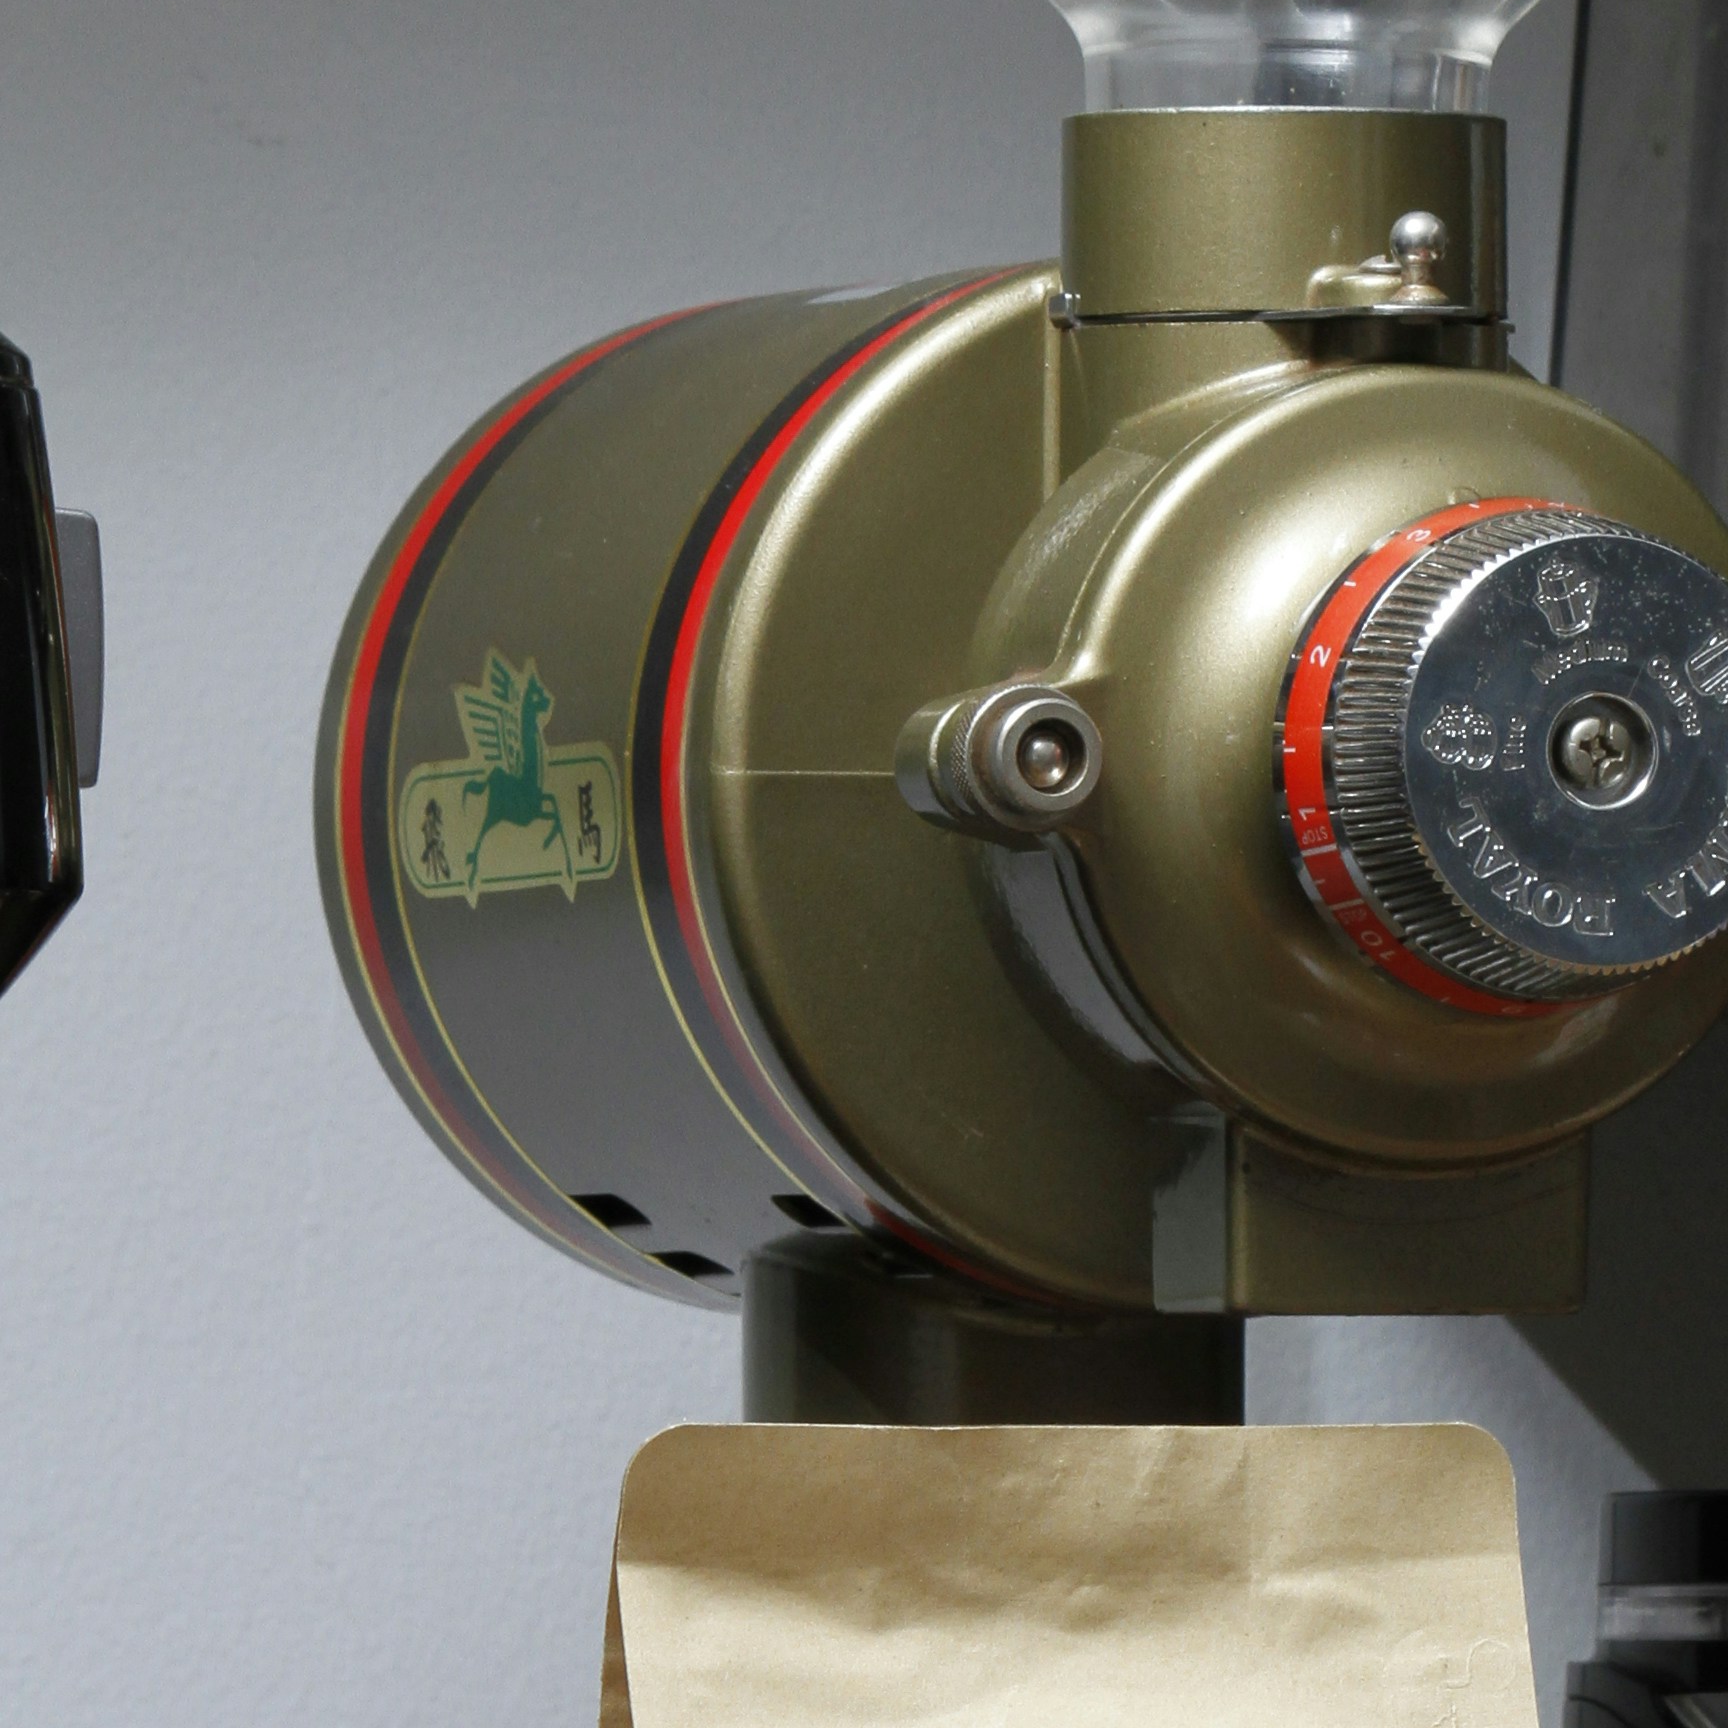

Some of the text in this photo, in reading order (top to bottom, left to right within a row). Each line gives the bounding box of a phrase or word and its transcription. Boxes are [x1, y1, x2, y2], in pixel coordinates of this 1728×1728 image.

[1405, 527, 1432, 542] 3
[1309, 644, 1332, 668] 2
[1531, 639, 1629, 684] Medium
[1647, 653, 1702, 737] Coarse
[576, 780, 602, 864] 馬
[1301, 825, 1329, 846] STOP
[1446, 795, 1617, 937] ROYAL
